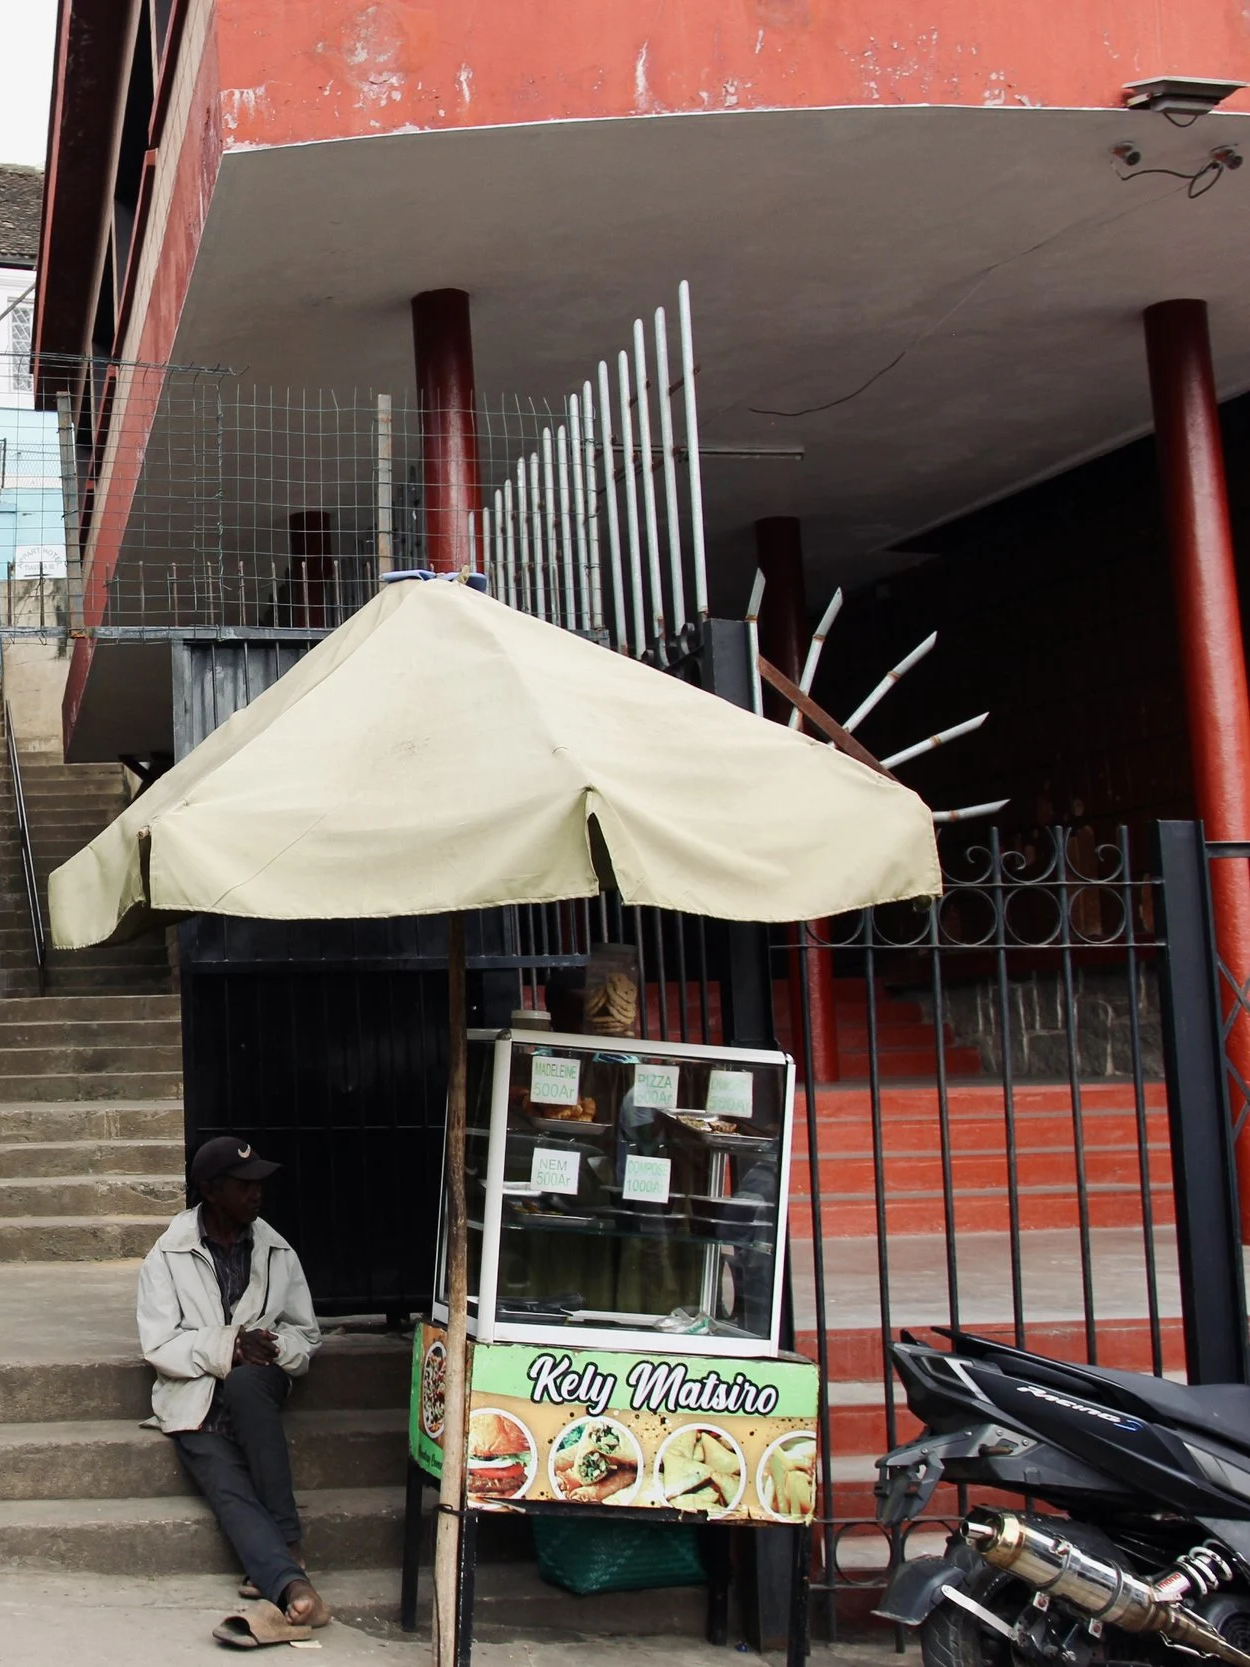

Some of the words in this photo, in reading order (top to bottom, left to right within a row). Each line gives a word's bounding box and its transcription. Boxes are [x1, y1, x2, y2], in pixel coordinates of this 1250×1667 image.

[638, 1073, 672, 1088] PIZZA
[533, 1082, 575, 1099] 500Ar
[539, 1158, 568, 1171] NEM
[536, 1171, 571, 1187] 500Ar
[528, 1352, 618, 1417] Kely
[626, 1361, 780, 1416] Matsiro
